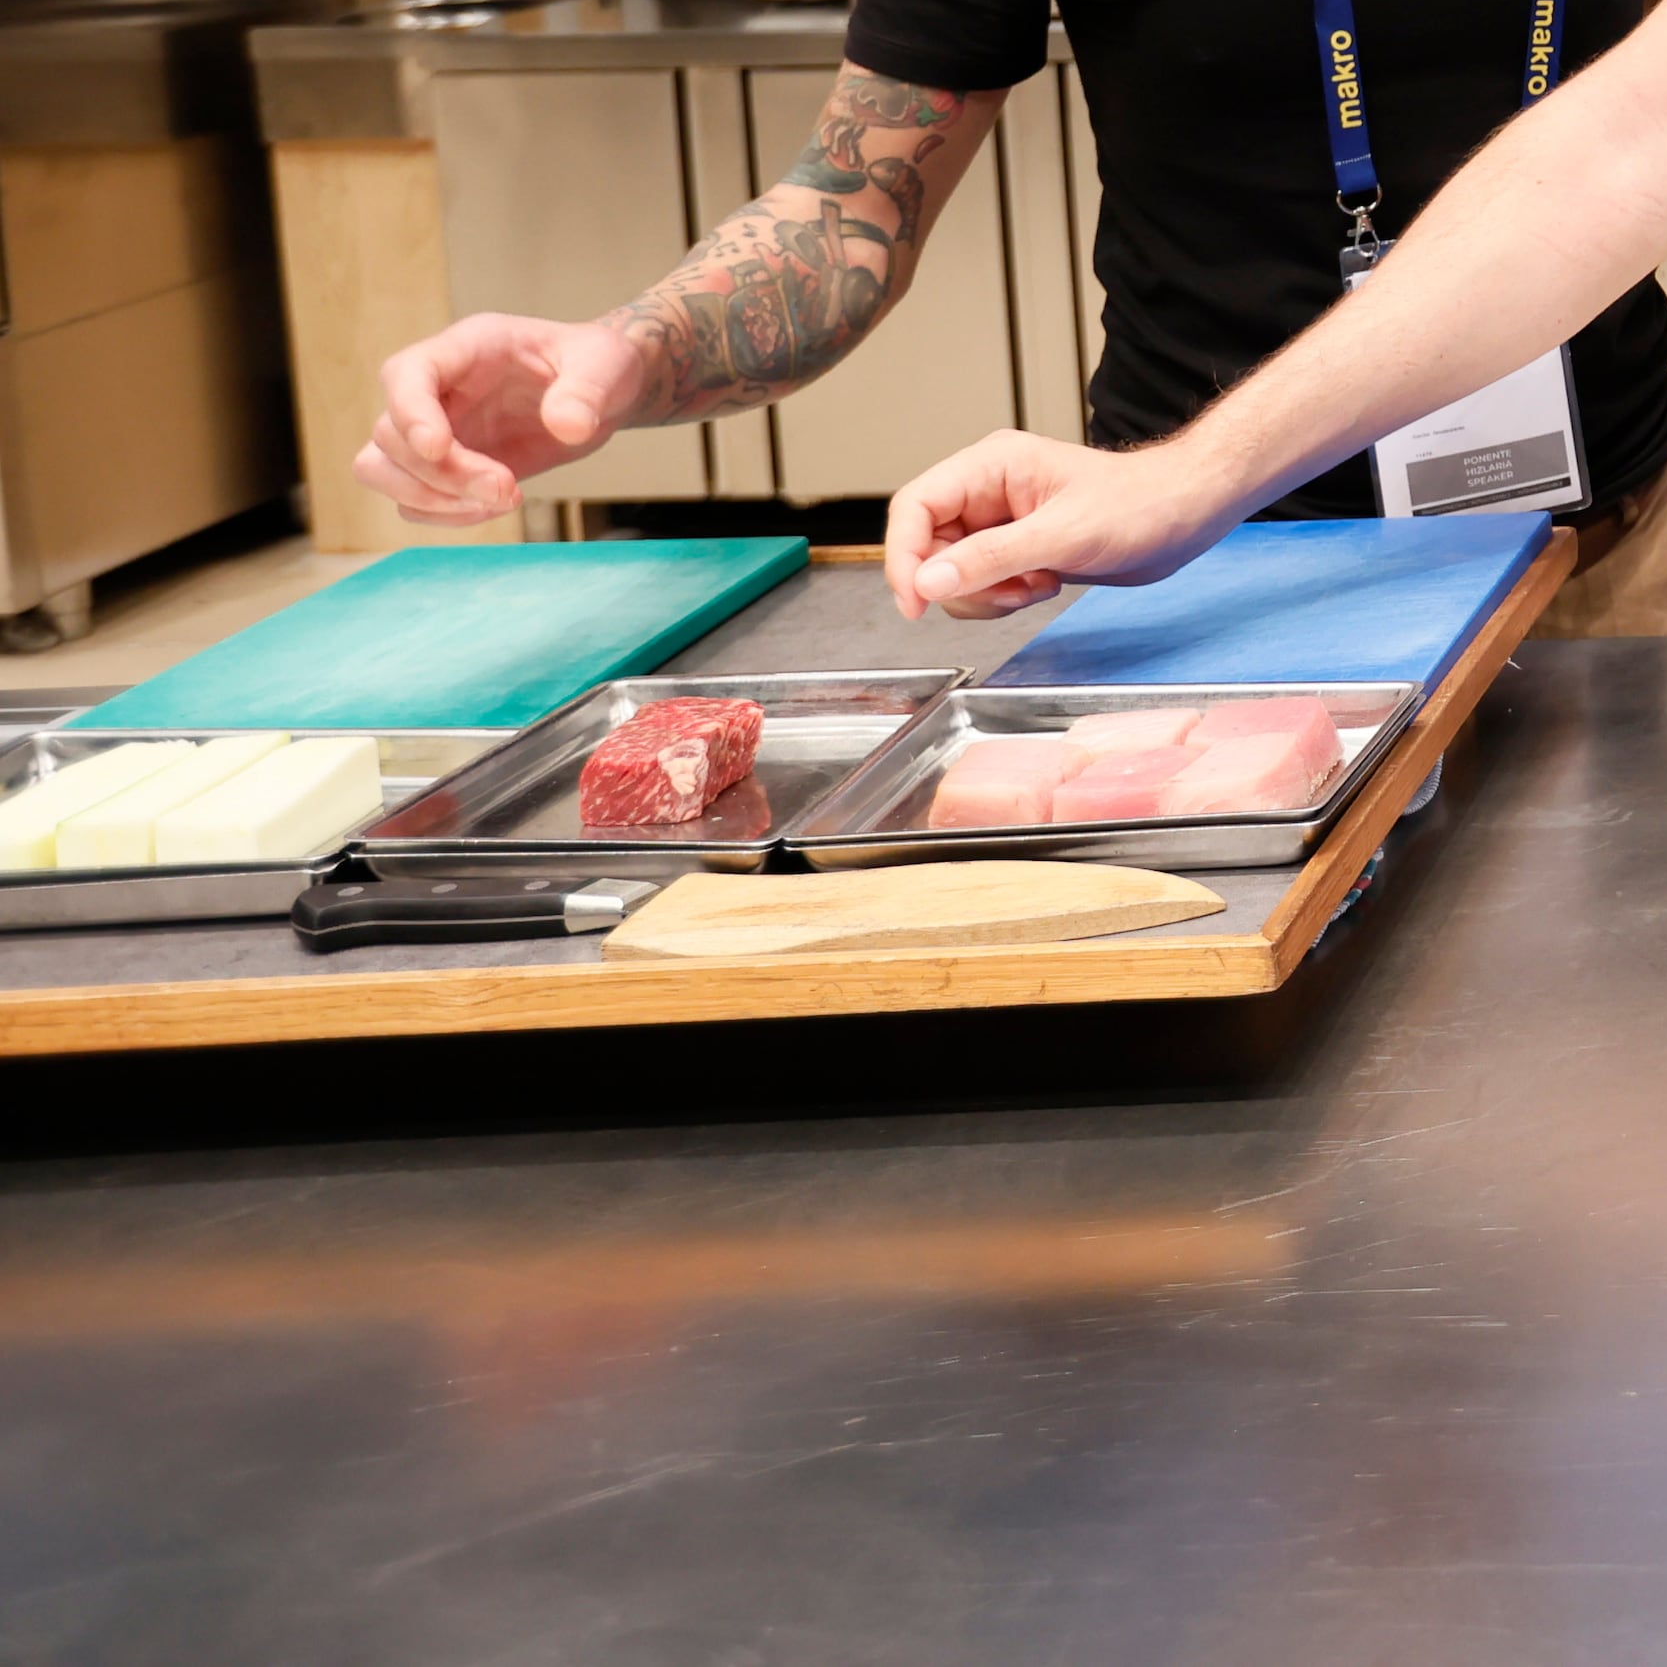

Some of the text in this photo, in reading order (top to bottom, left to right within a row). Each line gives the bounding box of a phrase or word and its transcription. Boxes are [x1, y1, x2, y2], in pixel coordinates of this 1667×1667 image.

[1528, 0, 1555, 95] makro
[1330, 28, 1363, 129] makro
[1463, 448, 1513, 466] PONENTE
[1467, 471, 1514, 488] SPEAKER
